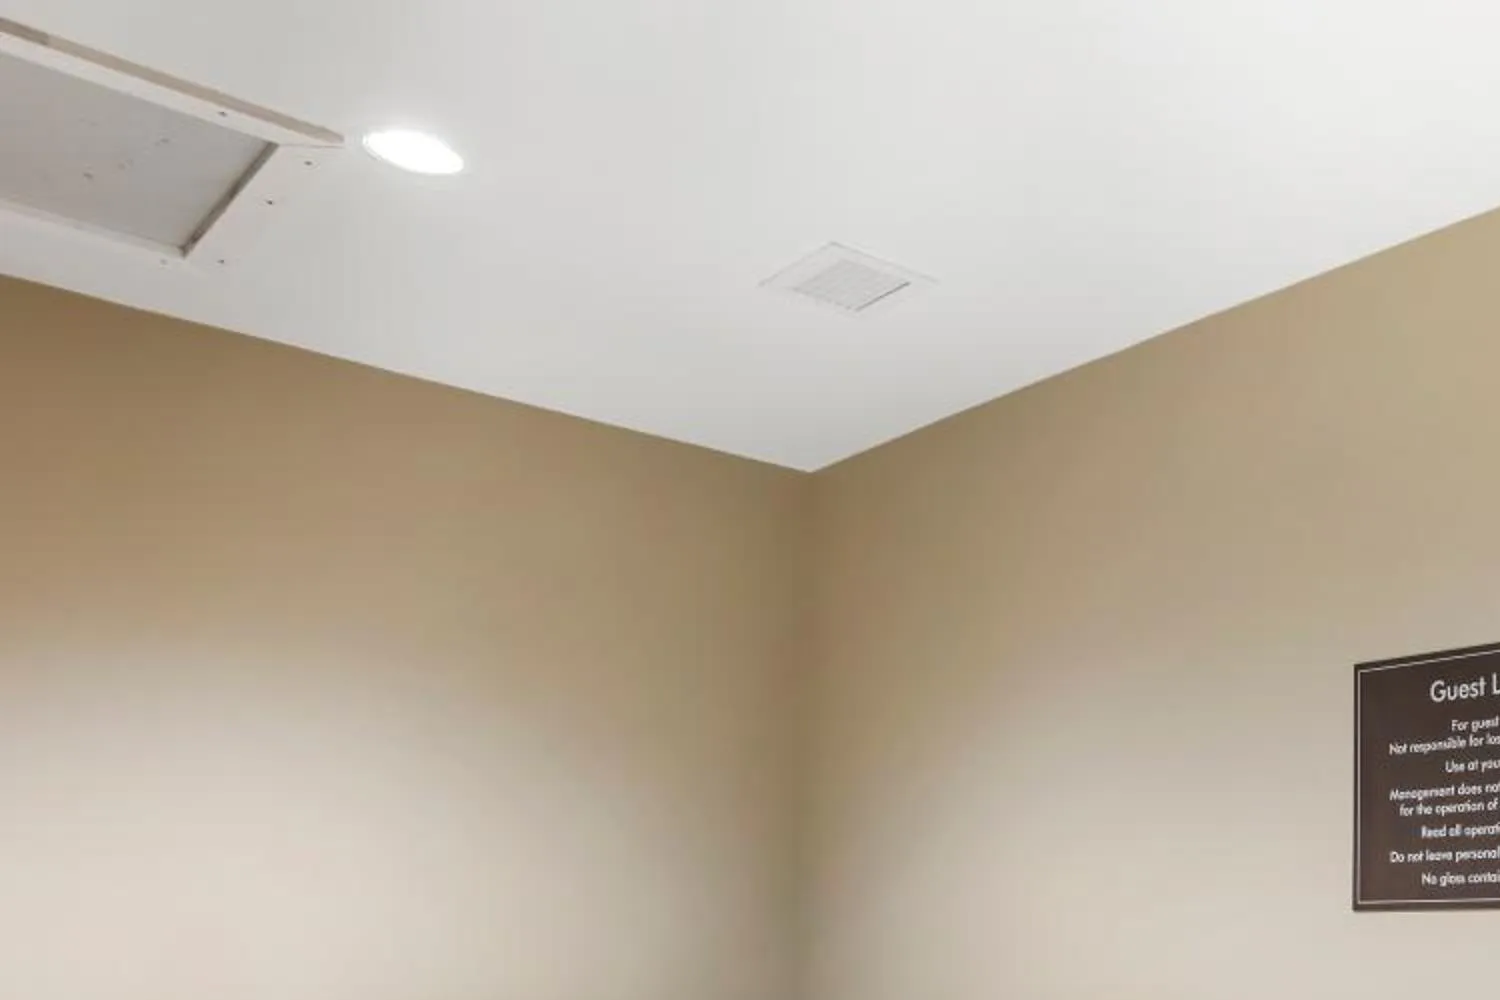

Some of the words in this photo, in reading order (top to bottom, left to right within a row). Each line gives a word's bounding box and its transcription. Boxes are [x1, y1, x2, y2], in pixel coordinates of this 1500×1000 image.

[1430, 676, 1486, 702] Guest
[1452, 719, 1469, 732] For
[1472, 716, 1499, 733] guest
[1389, 743, 1407, 755] Not
[1410, 737, 1467, 754] responsible
[1469, 733, 1484, 748] for
[1445, 760, 1465, 773] Use
[1468, 759, 1479, 771] at
[1390, 786, 1455, 801] Management
[1458, 783, 1482, 796] does
[1400, 804, 1413, 816] for
[1416, 803, 1432, 815] the
[1435, 800, 1484, 816] operation
[1487, 798, 1498, 811] of
[1421, 825, 1447, 838] Read
[1449, 824, 1462, 837] all
[1390, 850, 1405, 863] Do
[1407, 850, 1424, 862] not
[1425, 848, 1453, 861] leave
[1455, 846, 1500, 862] personal
[1421, 873, 1437, 885] No
[1440, 872, 1465, 887] glass
